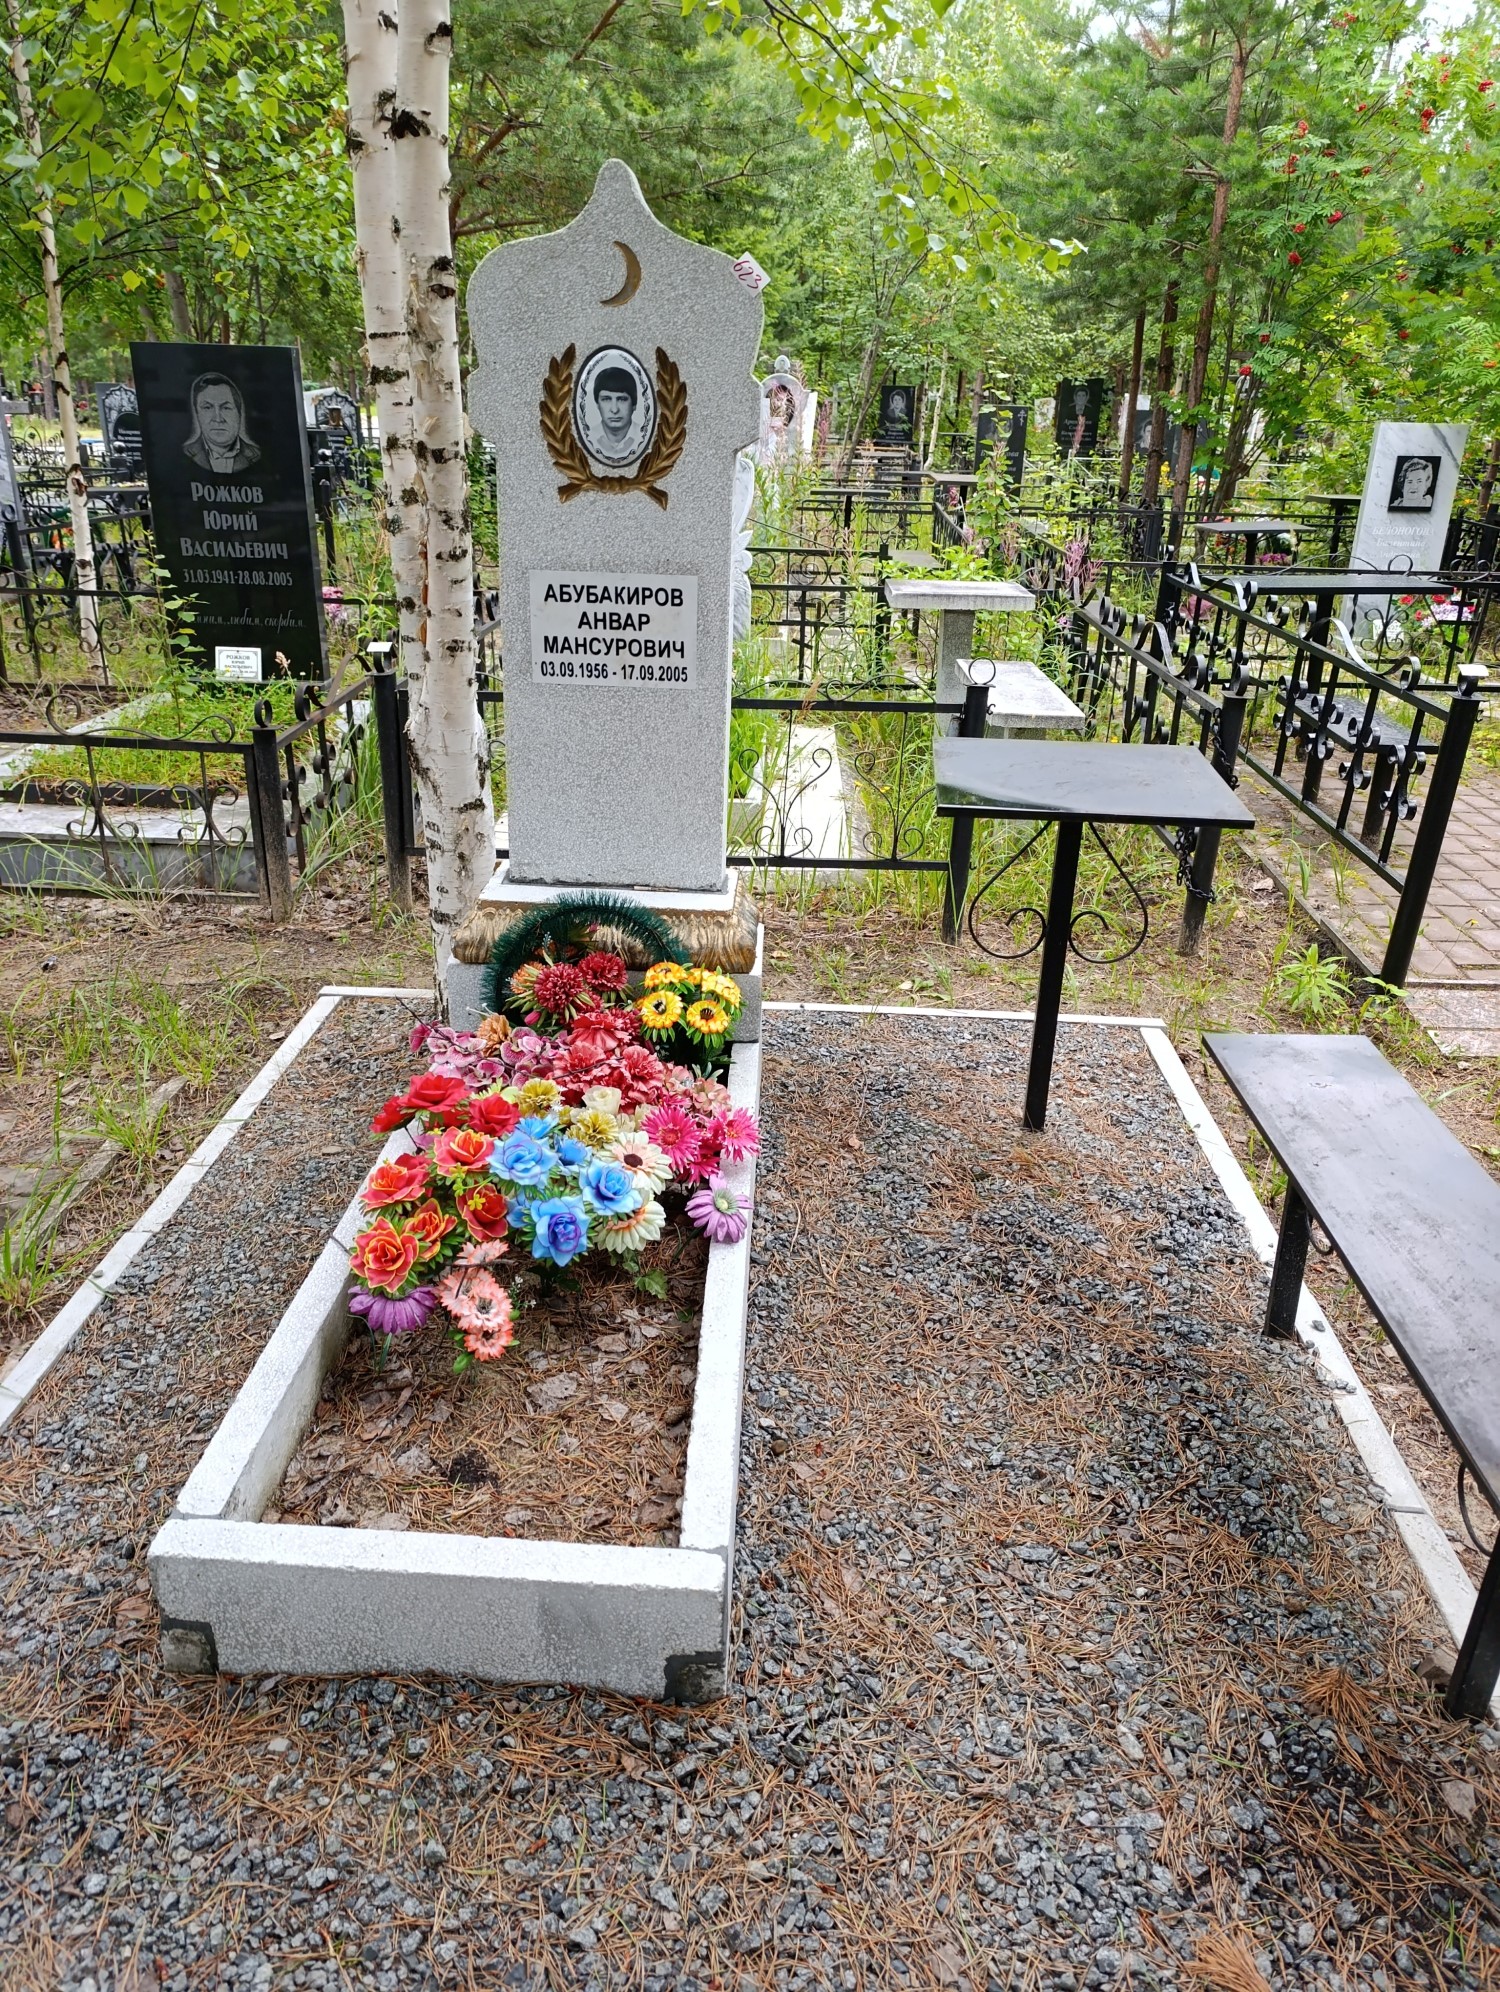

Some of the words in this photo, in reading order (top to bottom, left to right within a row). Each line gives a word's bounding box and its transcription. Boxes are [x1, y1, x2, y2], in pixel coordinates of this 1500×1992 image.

[733, 260, 762, 289] 623
[190, 481, 264, 504] РОЖКОВ
[203, 510, 258, 531] ЮРИЙ
[180, 537, 289, 559] ВАСИЛЬЕВИЧ
[183, 568, 293, 586] 31.03.1941-28.08.2005
[544, 583, 684, 607] АБУБАКИРОВ
[577, 611, 650, 632] АНВАР
[543, 635, 685, 659] МАНСУРОВИЧ
[541, 661, 608, 679] 03.09.1956
[621, 664, 688, 683] 17.09.2005
